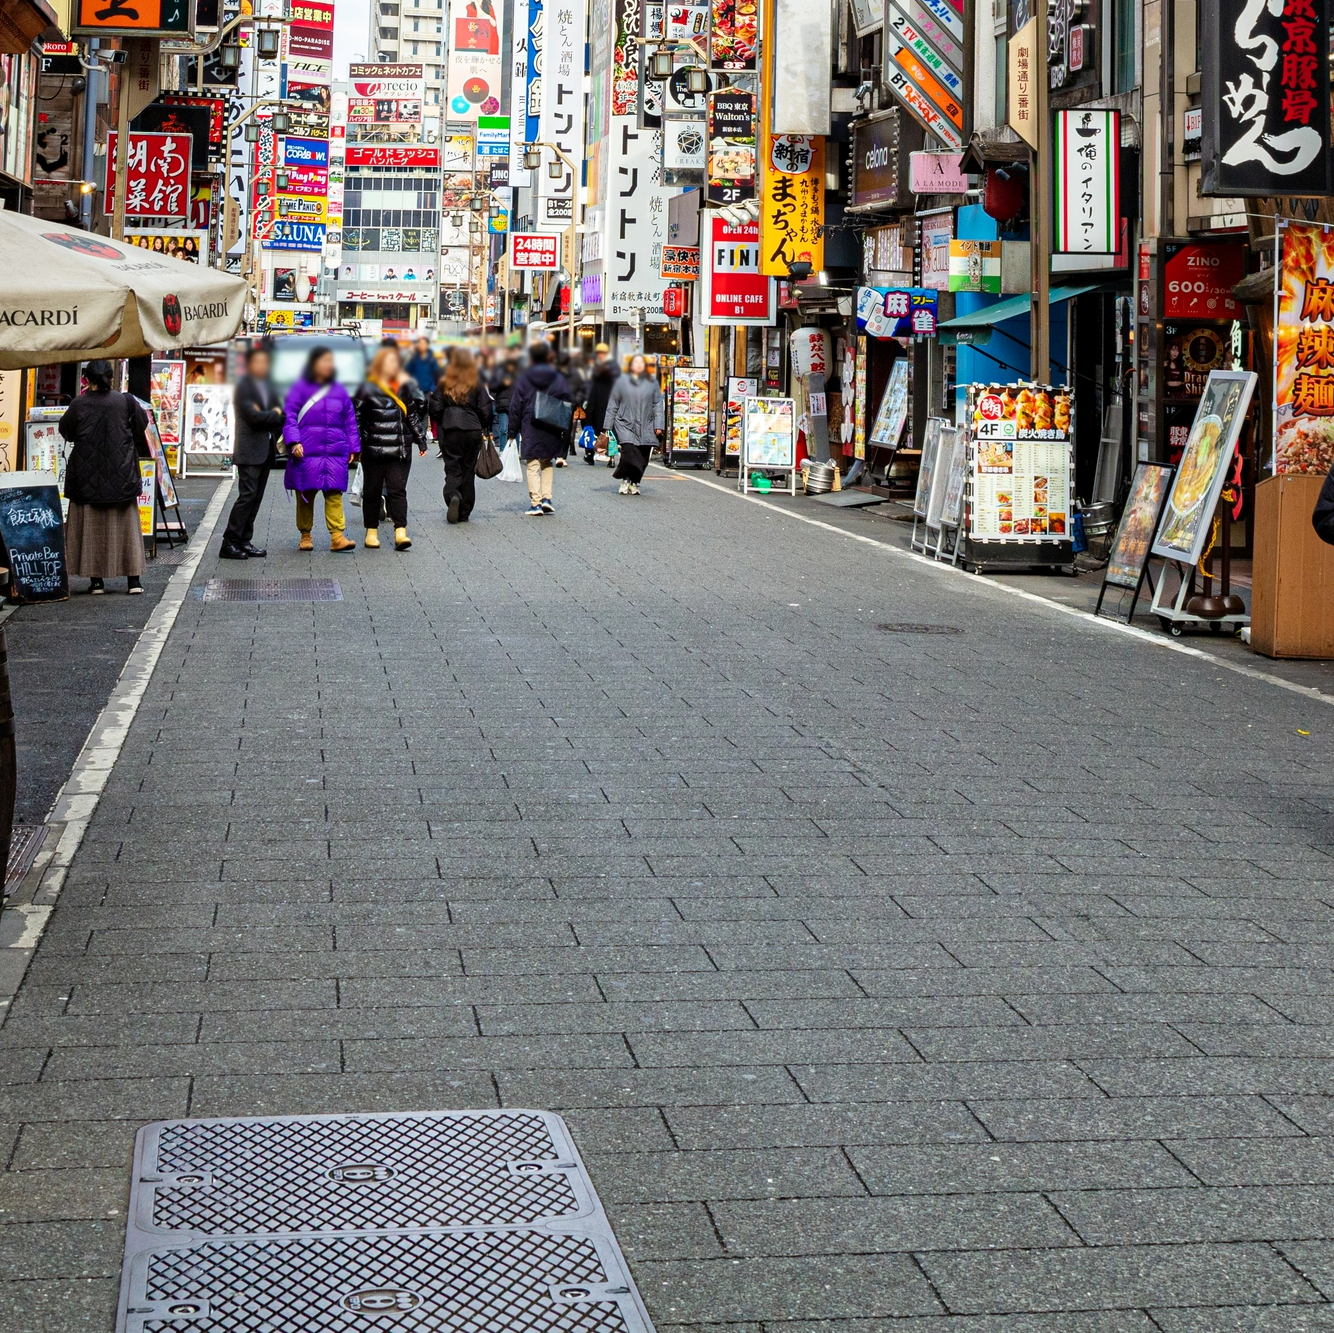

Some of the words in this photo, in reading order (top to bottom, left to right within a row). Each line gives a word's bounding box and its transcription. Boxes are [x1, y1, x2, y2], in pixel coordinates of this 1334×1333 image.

[351, 66, 421, 75] コミック&ネットカフェ
[723, 61, 746, 70] 3F
[1017, 46, 1029, 121] 劇場通り一番街
[717, 102, 733, 111] BBQ
[735, 102, 749, 111] 東京
[715, 112, 750, 122] Walton's
[354, 149, 435, 157] ゴールドラッシュ
[125, 178, 184, 214] 菜館
[722, 189, 741, 201] 2F
[1075, 140, 1096, 252] 俺のイタリアン
[616, 124, 639, 283] トントン
[770, 176, 797, 266] まっちゃん
[275, 222, 323, 243] SAUNA
[516, 238, 555, 252] 24時間
[516, 252, 555, 265] 営業中
[1187, 256, 1220, 267] ZINO
[1169, 281, 1205, 293] 600
[346, 292, 374, 300] コーヒー
[395, 293, 416, 301] クール
[715, 294, 740, 304] ONLINE
[742, 294, 763, 304] CAFE
[734, 305, 744, 315] B1
[979, 425, 998, 436] 4F
[10, 549, 43, 562] Private
[44, 549, 59, 560] Bar
